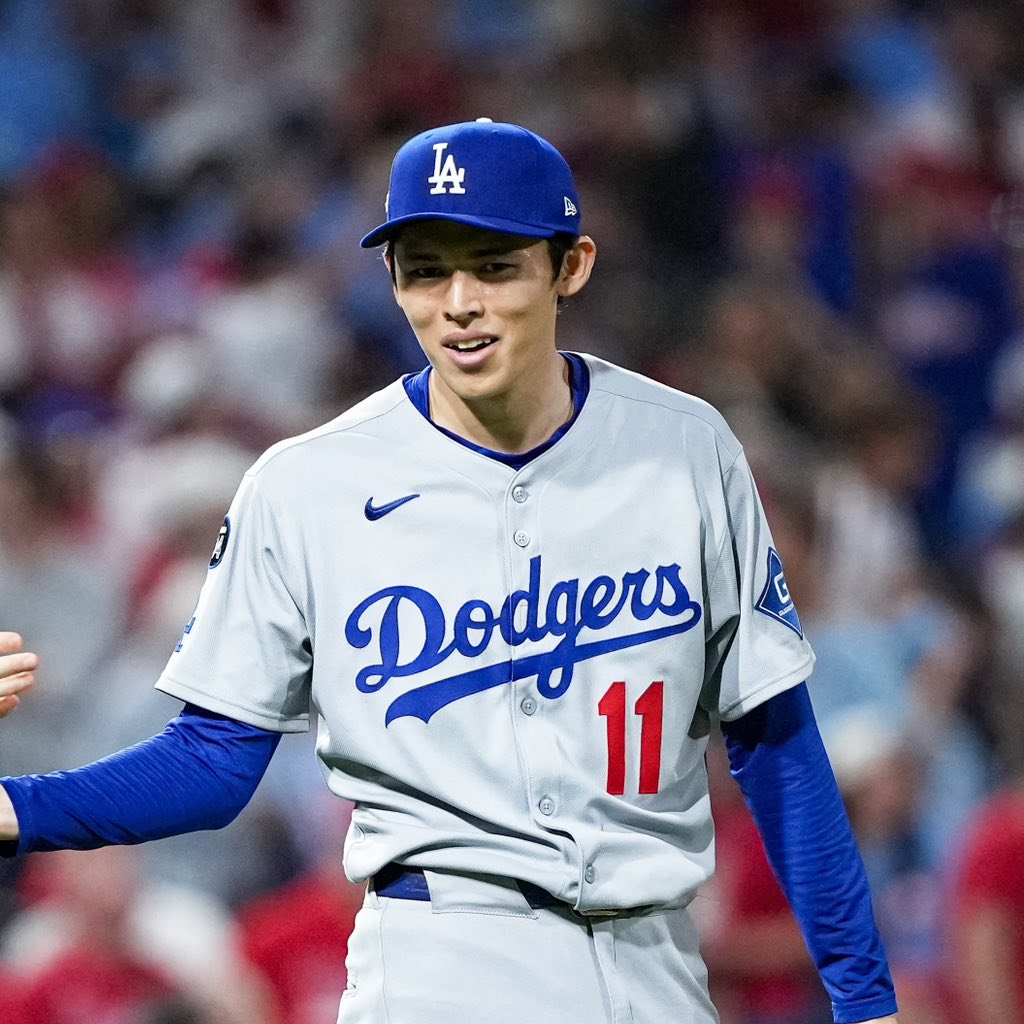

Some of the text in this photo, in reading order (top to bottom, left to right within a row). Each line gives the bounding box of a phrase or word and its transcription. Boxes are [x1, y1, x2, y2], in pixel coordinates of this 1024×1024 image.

[428, 142, 466, 195] LA
[344, 554, 703, 729] Dodgers
[598, 681, 665, 795] 11
